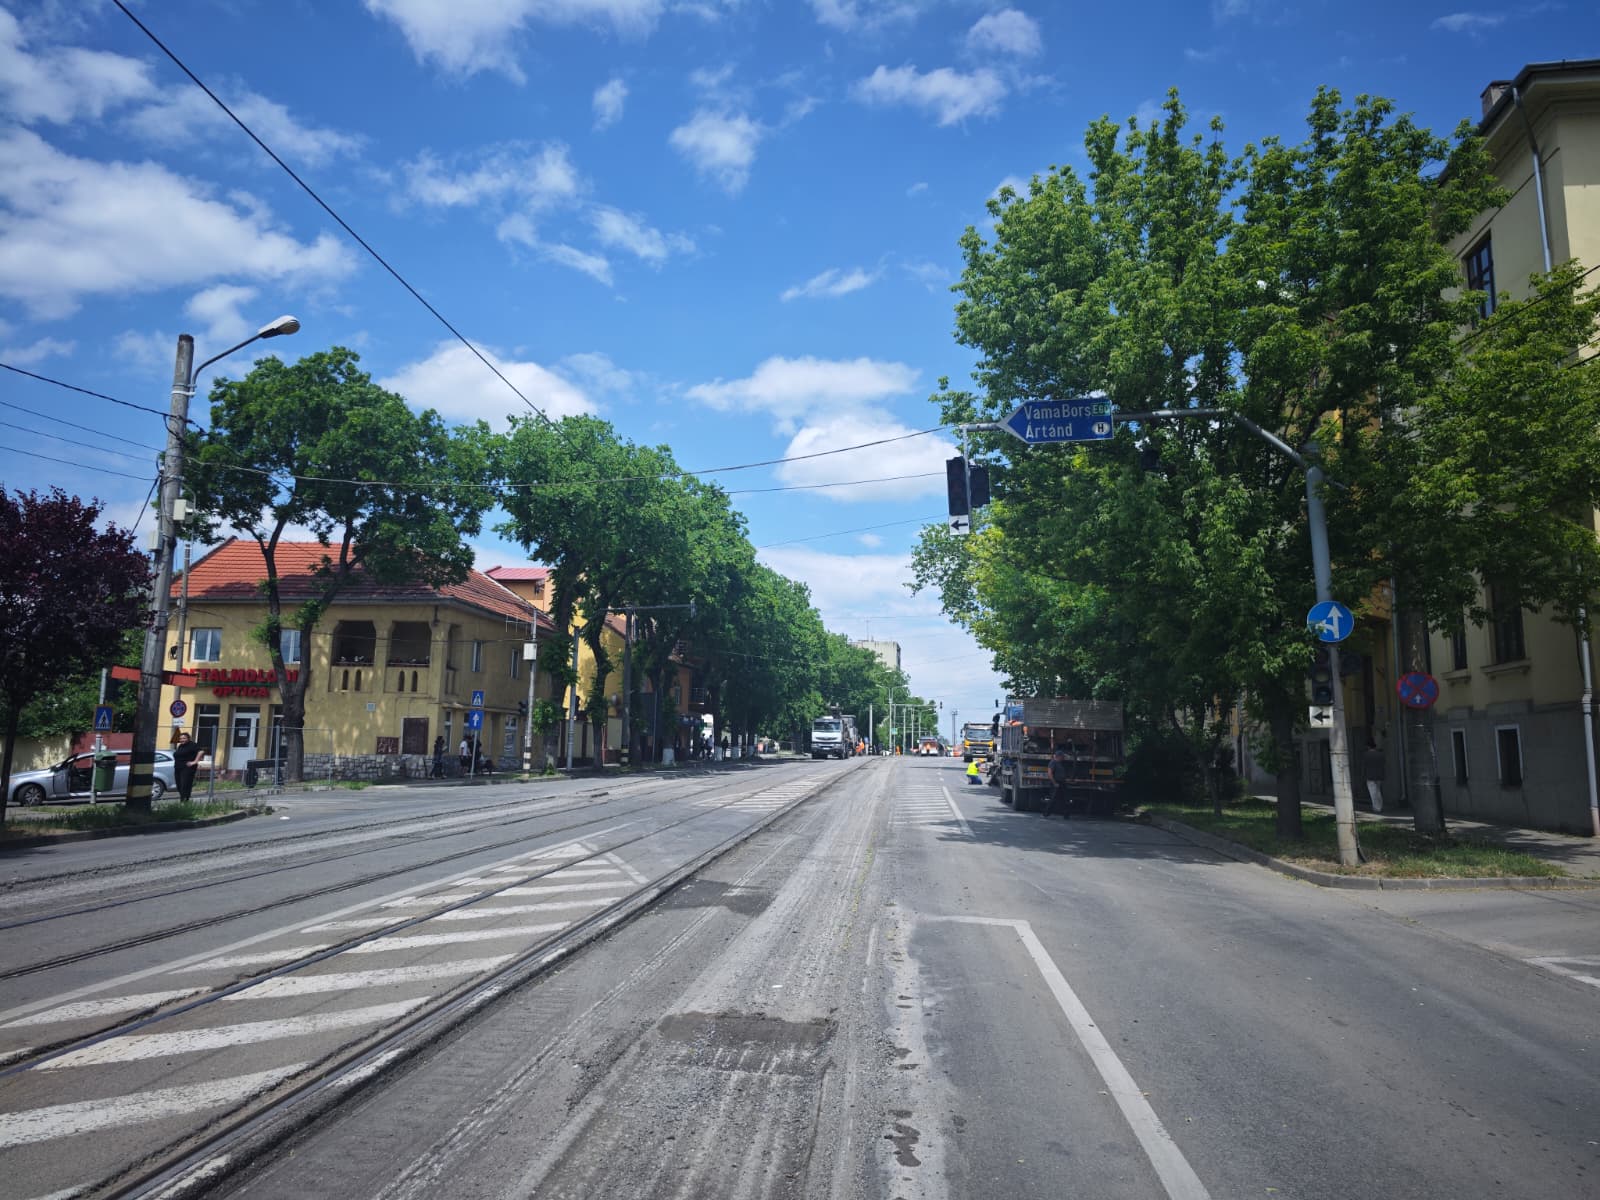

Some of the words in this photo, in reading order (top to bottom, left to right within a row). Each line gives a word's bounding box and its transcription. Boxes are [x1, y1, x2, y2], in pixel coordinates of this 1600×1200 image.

[1024, 405, 1061, 420] Vama
[1025, 421, 1073, 439] Ártánd
[1097, 423, 1104, 433] H
[212, 686, 270, 697] OPTICA
